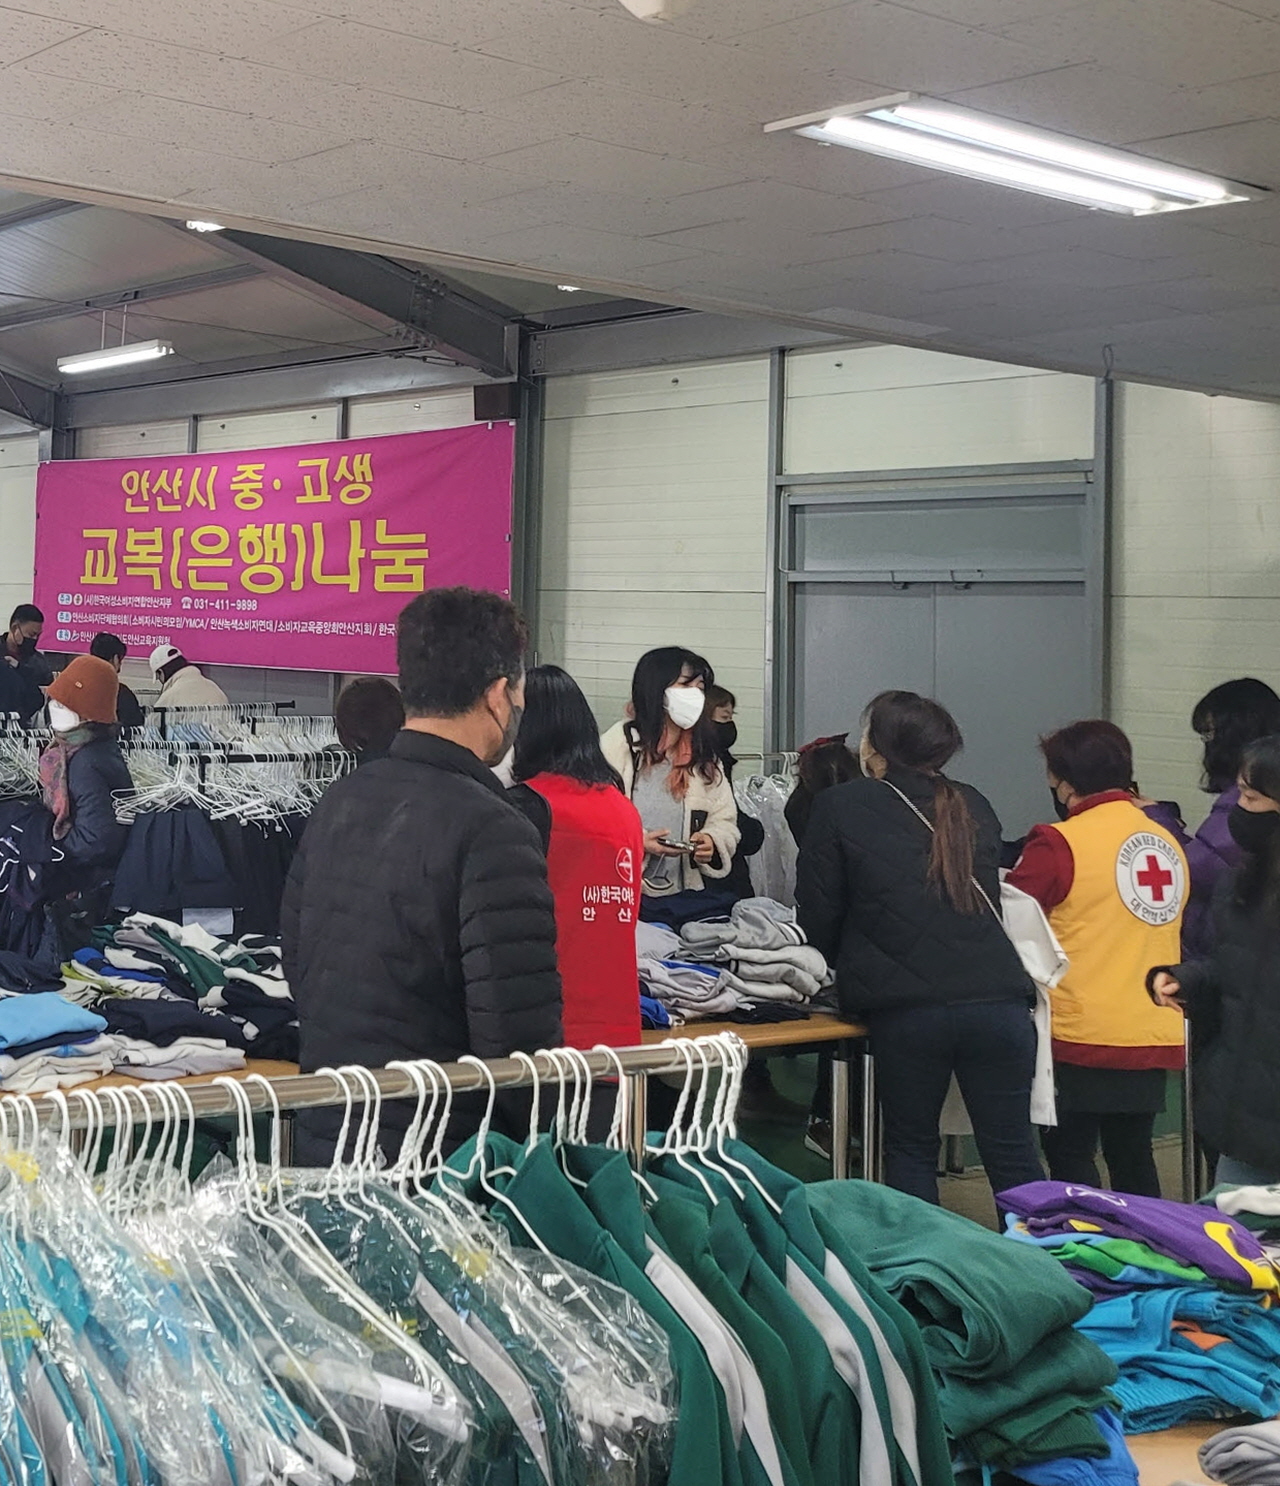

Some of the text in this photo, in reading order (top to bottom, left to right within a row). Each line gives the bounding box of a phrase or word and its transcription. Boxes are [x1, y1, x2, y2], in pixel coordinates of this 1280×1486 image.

[121, 466, 218, 513] 안산시
[194, 599, 257, 611] 031-411-9898
[379, 623, 397, 636] 한국
[1120, 837, 1143, 867] KOREAN
